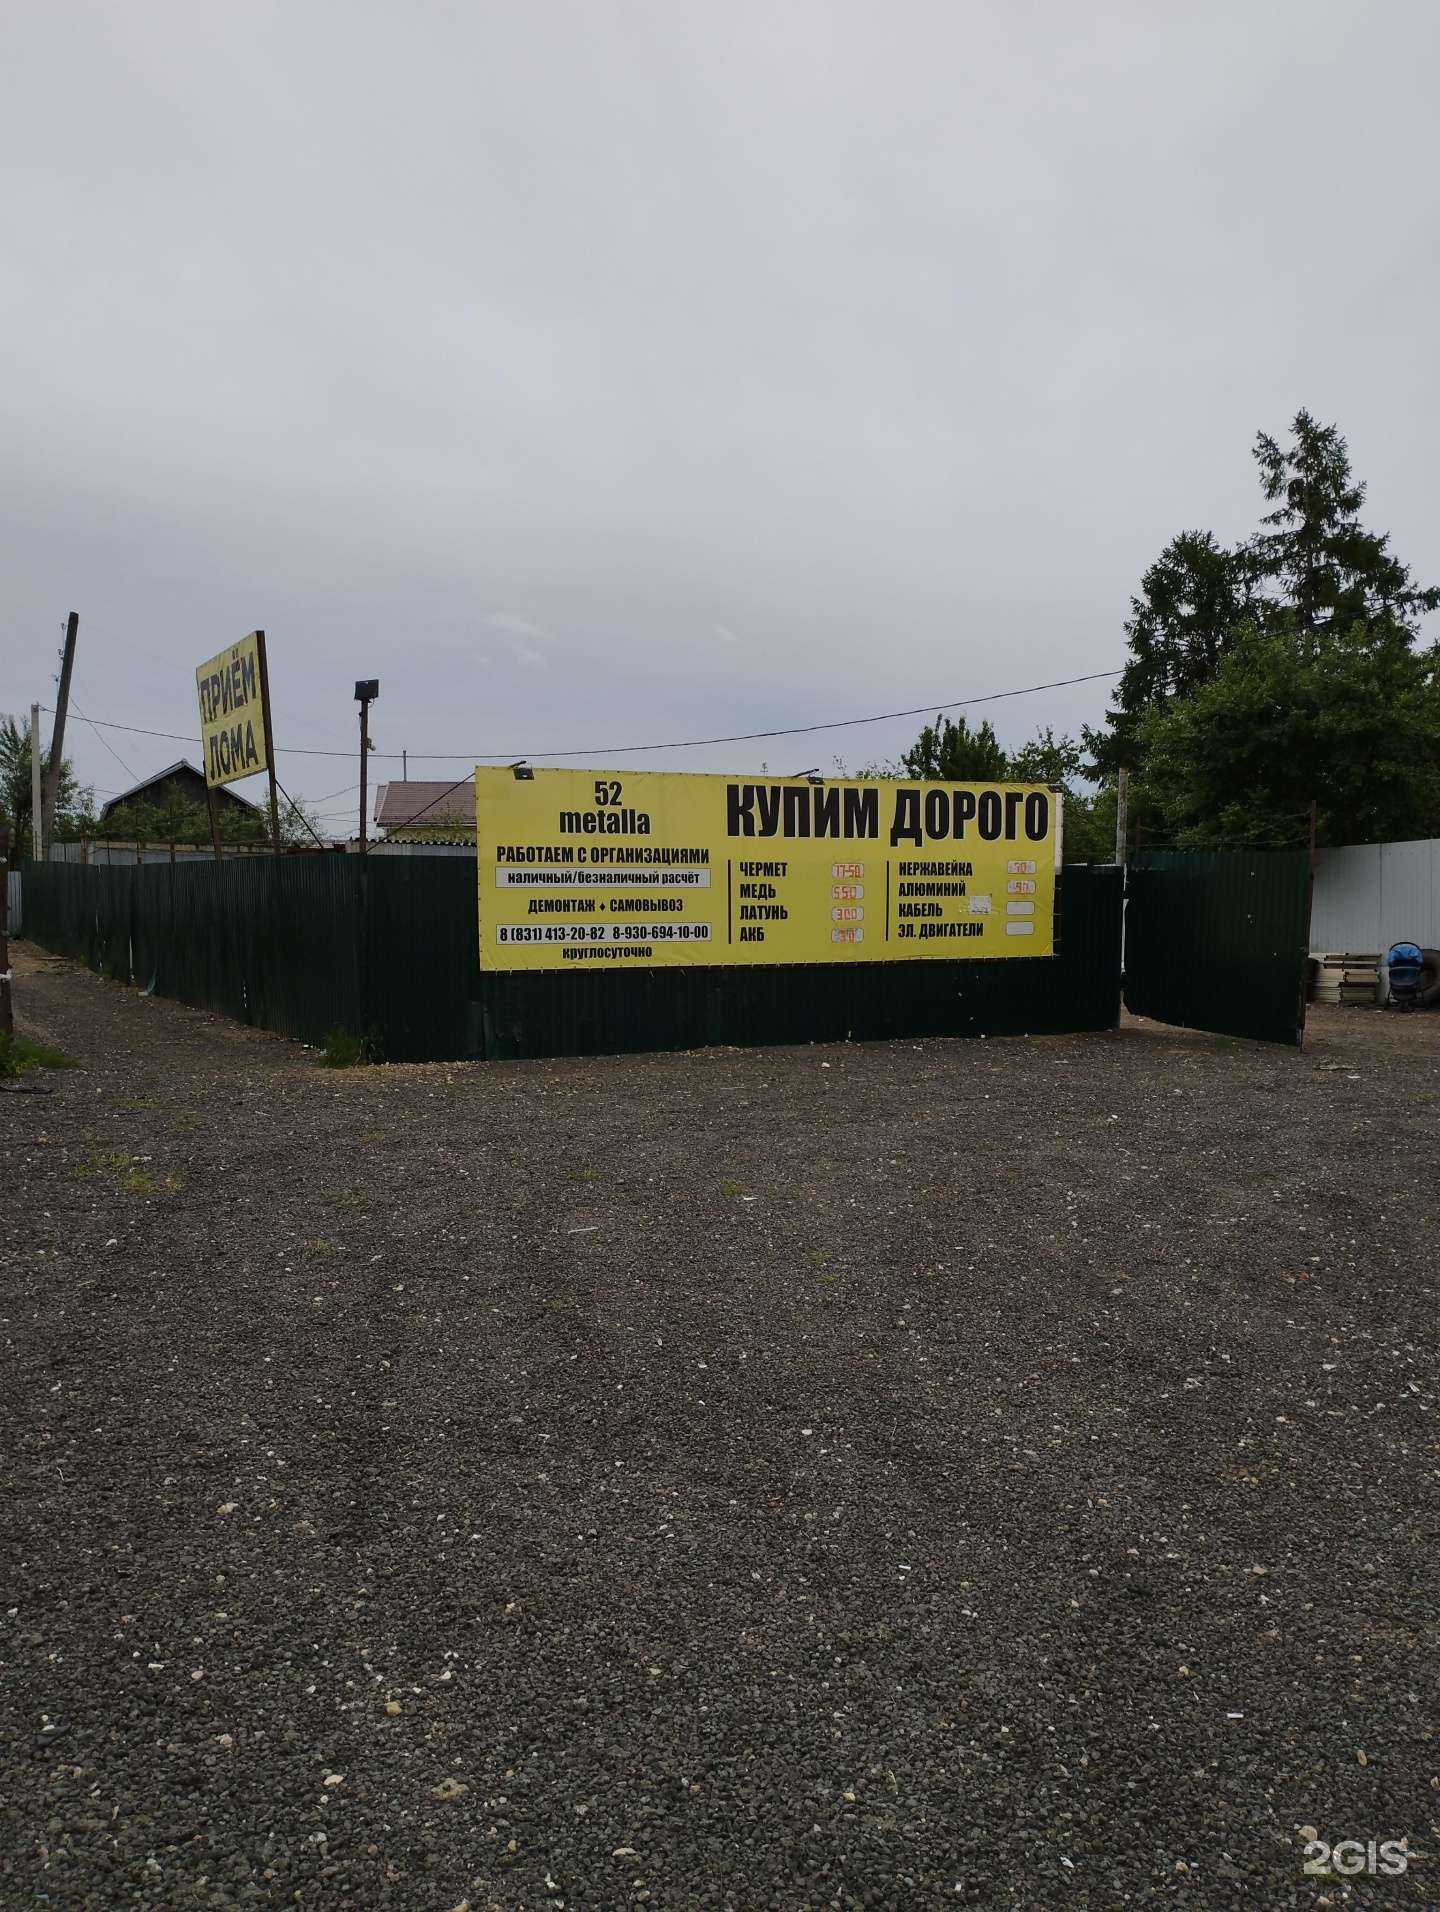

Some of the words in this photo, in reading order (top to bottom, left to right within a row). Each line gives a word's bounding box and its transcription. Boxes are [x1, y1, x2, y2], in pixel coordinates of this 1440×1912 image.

[200, 648, 257, 724] ПРИЁМ
[210, 720, 259, 781] ЛОМА
[594, 780, 623, 806] 52
[559, 809, 651, 835] metalla
[727, 784, 879, 839] КУПИМ
[890, 789, 1049, 847] ДОРОГО
[496, 846, 574, 864] РАБОТАЕМ
[577, 847, 587, 863] С
[590, 847, 710, 866] ОРГАНИЗАЦИЯМИ
[739, 861, 788, 878] ЧЕРМЕТ
[898, 859, 974, 877] НЕРЖАВЕЙКА
[507, 869, 660, 886] наличный/безналичный
[662, 869, 700, 887] расчёт
[739, 883, 777, 900] МЕДЬ
[898, 879, 967, 897] АЛЮМИНИЙ
[527, 899, 596, 915] ДЕМОНТАЖ
[609, 898, 684, 913] САМОВЫВОЗ
[739, 904, 789, 921] ЛАТУНЬ
[898, 901, 943, 918] КАБЕЛЬ
[500, 928, 508, 942] 8
[511, 926, 542, 942] (831)
[545, 926, 605, 941] 413-20-82
[612, 924, 709, 940] 8-930-694-10-00
[739, 926, 766, 942] АКБ
[898, 924, 917, 939] ЭЛ.
[918, 922, 984, 940] ДВИГАТЕЛИ
[562, 946, 653, 960] круглосуточно
